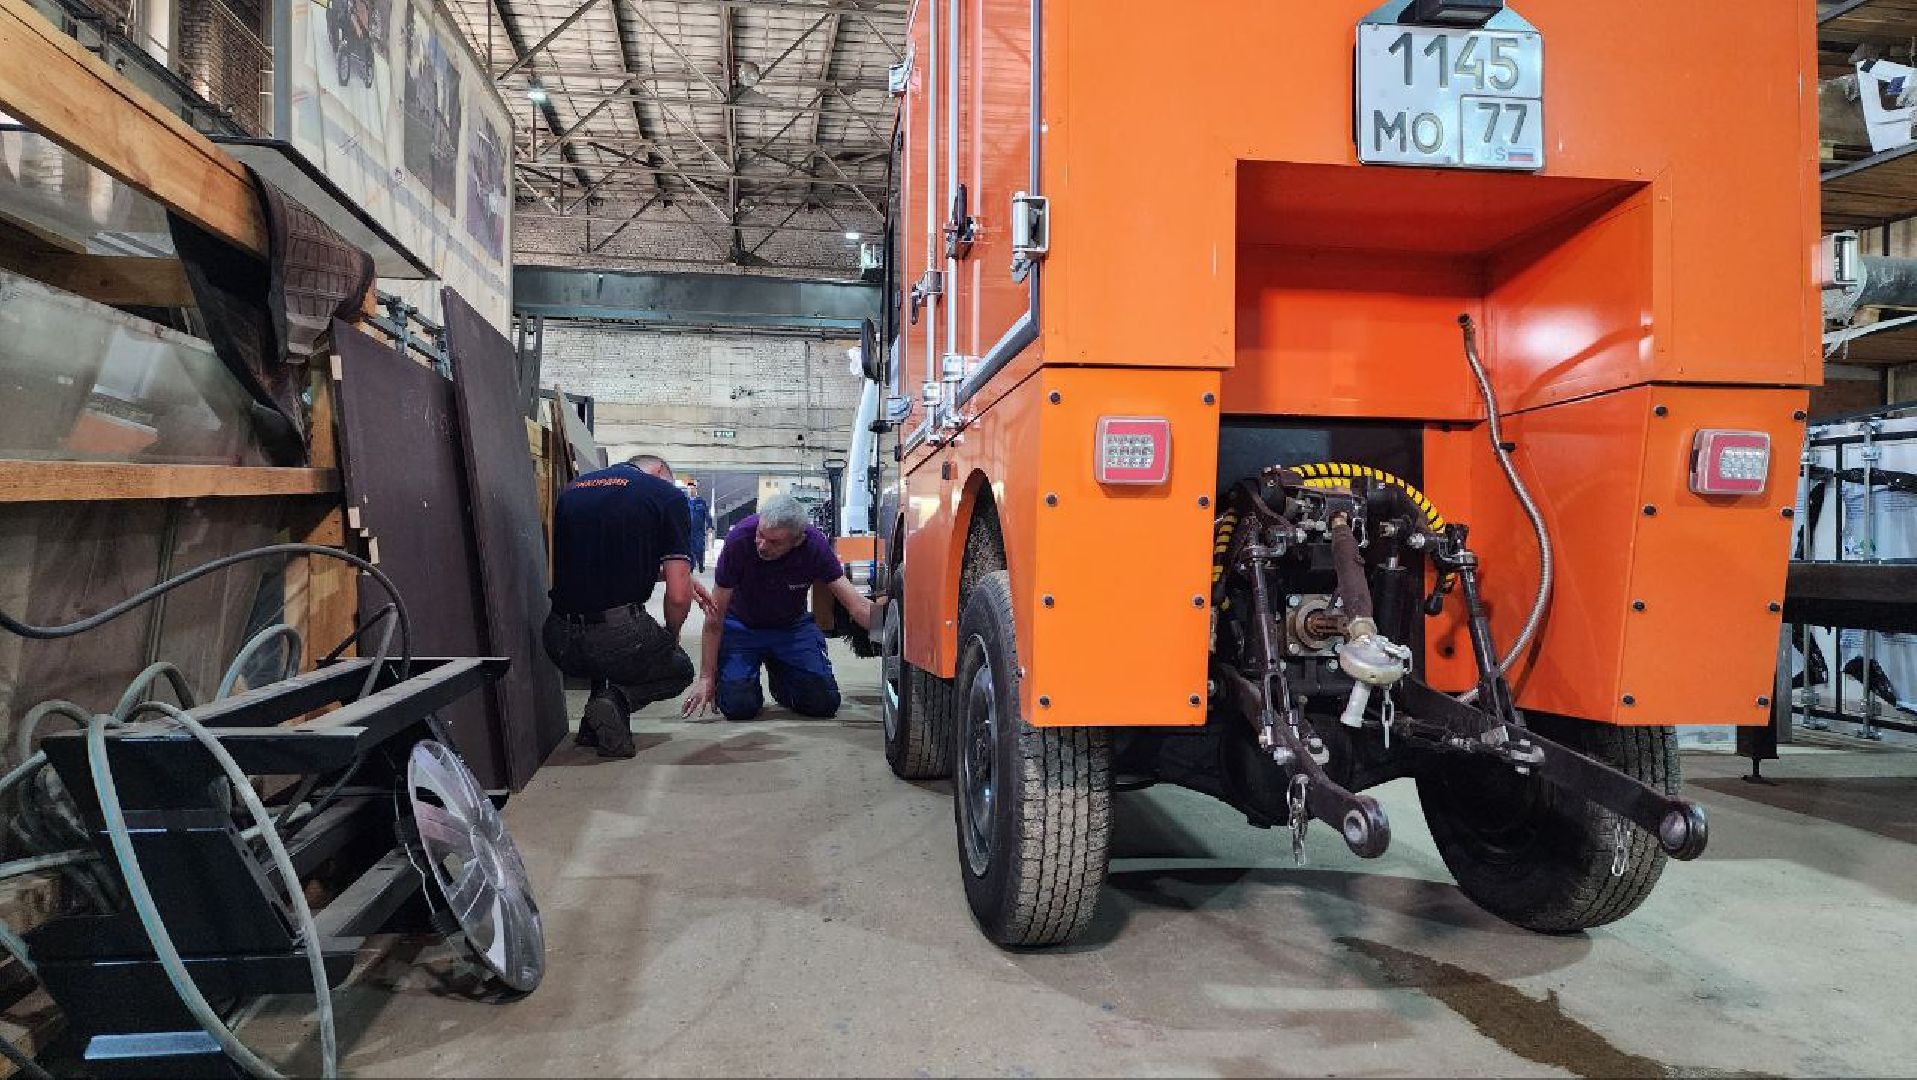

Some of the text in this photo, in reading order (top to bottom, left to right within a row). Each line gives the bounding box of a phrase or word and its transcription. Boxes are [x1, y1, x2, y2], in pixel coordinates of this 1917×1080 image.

[1388, 32, 1519, 90] 1145
[1373, 109, 1444, 154] МО
[1478, 102, 1528, 144] 77
